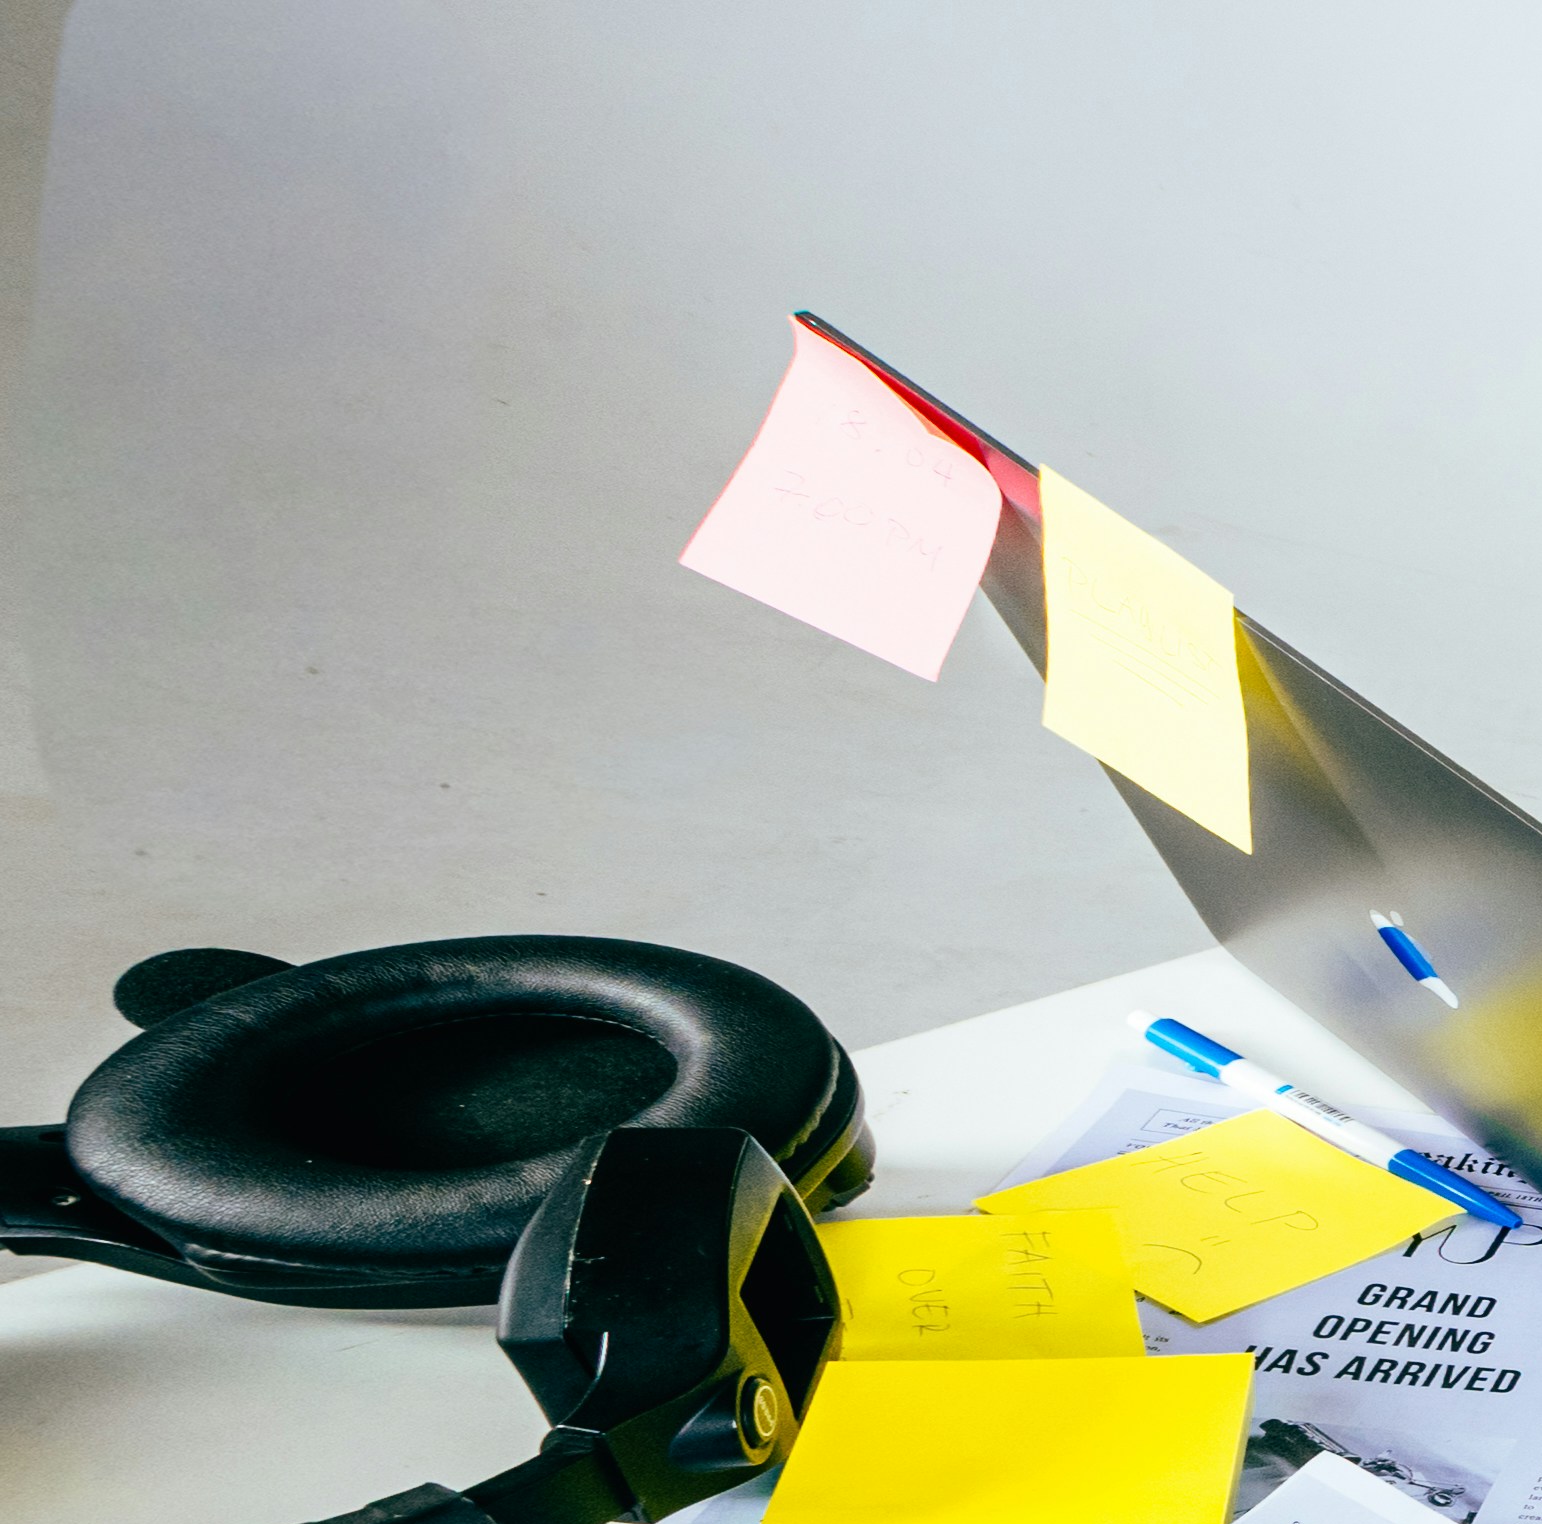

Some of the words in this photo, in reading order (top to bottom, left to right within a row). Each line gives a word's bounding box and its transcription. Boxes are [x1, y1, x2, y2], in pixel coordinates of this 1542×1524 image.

[1131, 1152, 1319, 1232] HELP
[898, 1268, 950, 1335] OVER
[1001, 1230, 1056, 1318] FAITH
[1357, 1282, 1498, 1319] GRAND
[1312, 1315, 1496, 1355] OPENING
[1244, 1345, 1329, 1377] HAS
[1335, 1354, 1522, 1394] ARRIVED
